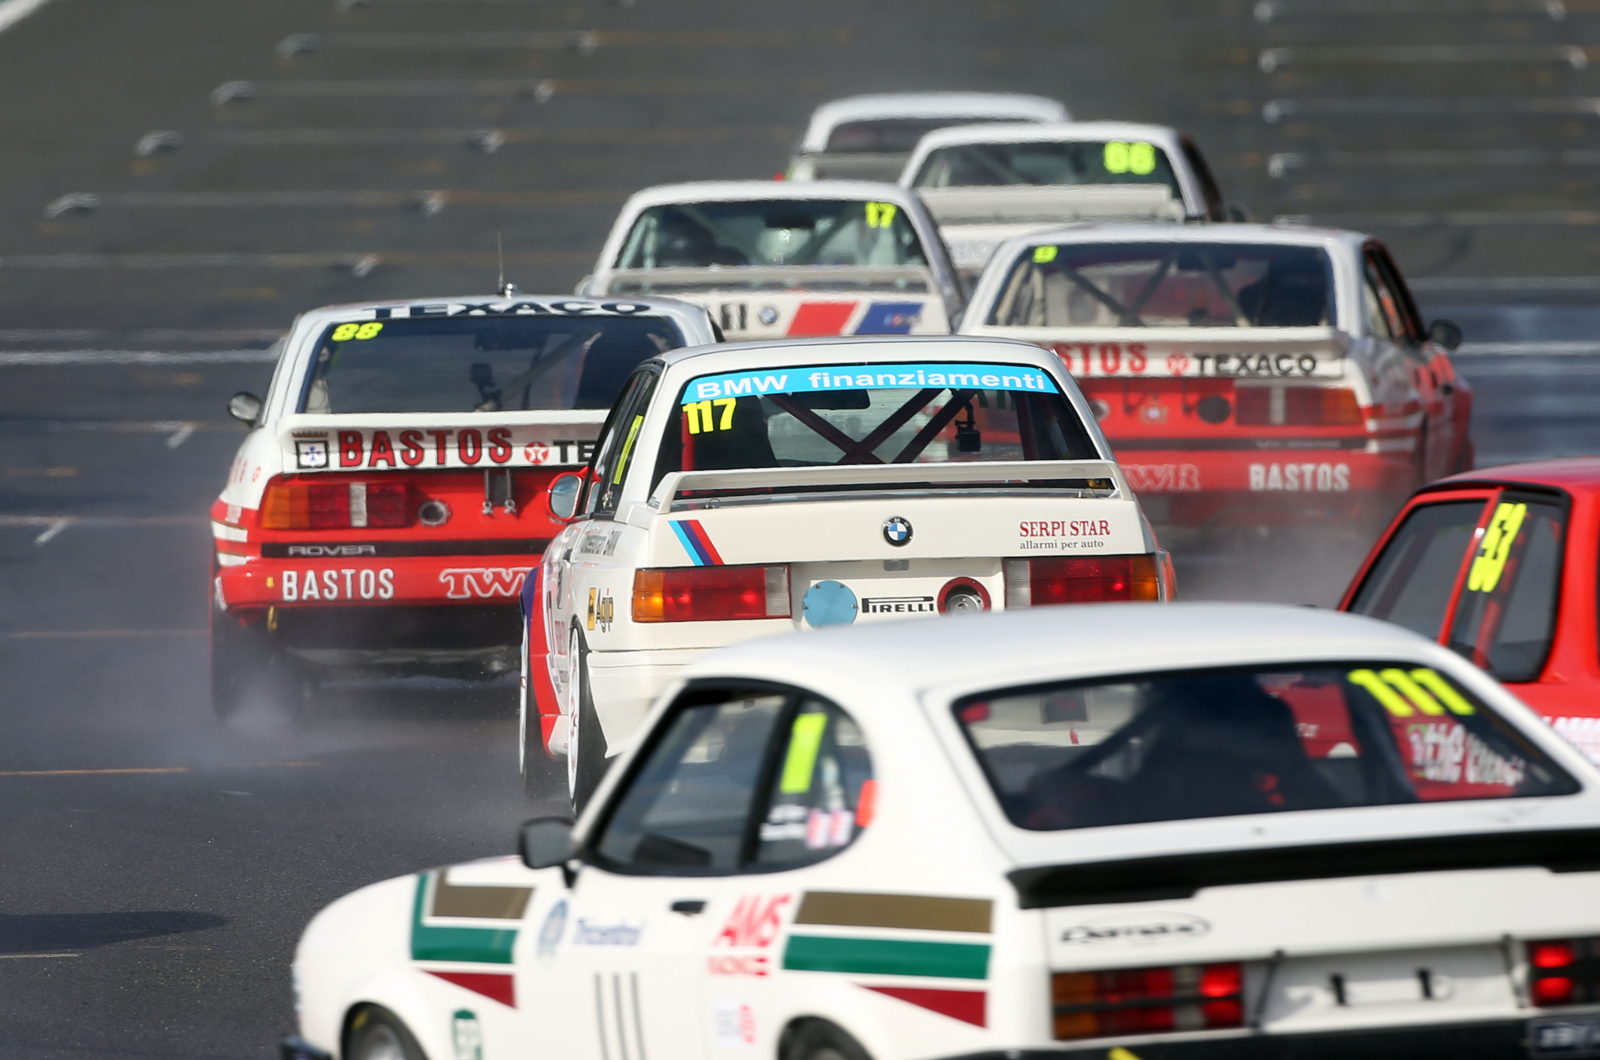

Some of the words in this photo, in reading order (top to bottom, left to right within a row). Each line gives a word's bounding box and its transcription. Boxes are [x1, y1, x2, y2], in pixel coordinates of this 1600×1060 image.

[865, 201, 897, 228] 17
[362, 301, 651, 318] TEXACO
[331, 321, 384, 342] 88
[1053, 341, 1148, 377] STOS
[1193, 354, 1317, 376] TEXACO
[696, 374, 789, 399] BMW
[808, 370, 1045, 390] finanziamenti
[682, 397, 736, 434] 117
[337, 427, 514, 468] BASTOS
[553, 440, 598, 463] TE
[1119, 464, 1201, 497] WR
[1248, 463, 1350, 492] BASTOS
[1019, 521, 1066, 537] SERPI
[1070, 519, 1111, 536] STAR
[288, 544, 377, 557] ROVER
[1019, 540, 1058, 550] allarmi
[1061, 541, 1078, 551] per
[1081, 540, 1104, 548] auto
[281, 568, 395, 602] BASTOS
[438, 567, 535, 599] TW
[861, 596, 934, 614] PIRELLI
[1347, 668, 1476, 717] 111
